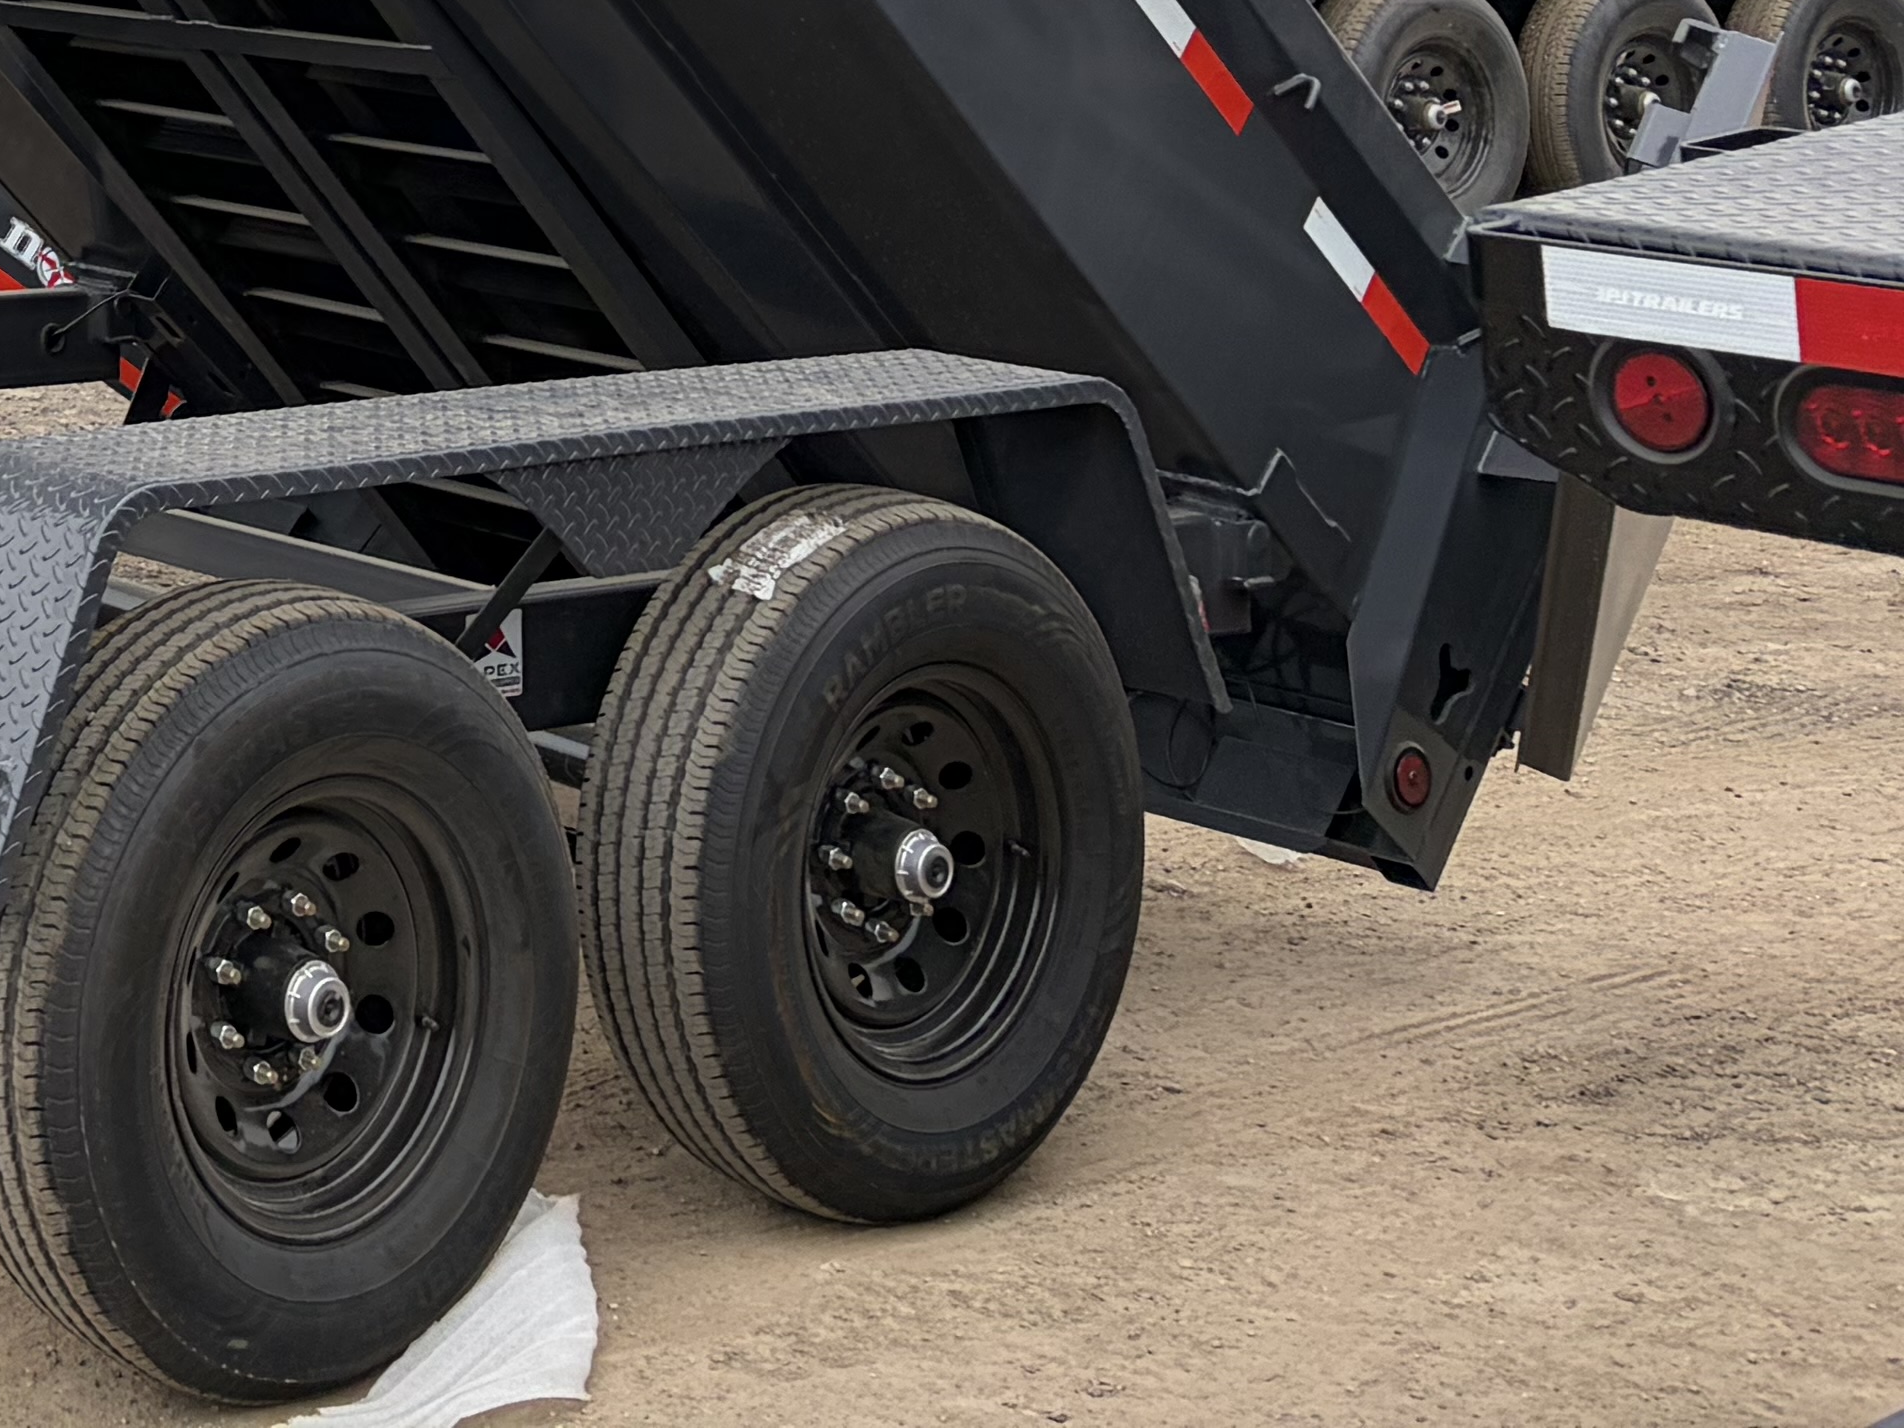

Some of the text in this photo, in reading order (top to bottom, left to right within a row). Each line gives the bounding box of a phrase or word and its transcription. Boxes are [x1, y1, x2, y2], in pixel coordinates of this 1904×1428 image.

[1632, 291, 1744, 320] TRAILERS
[822, 583, 968, 712] RAMBLER
[483, 661, 521, 677] PEX
